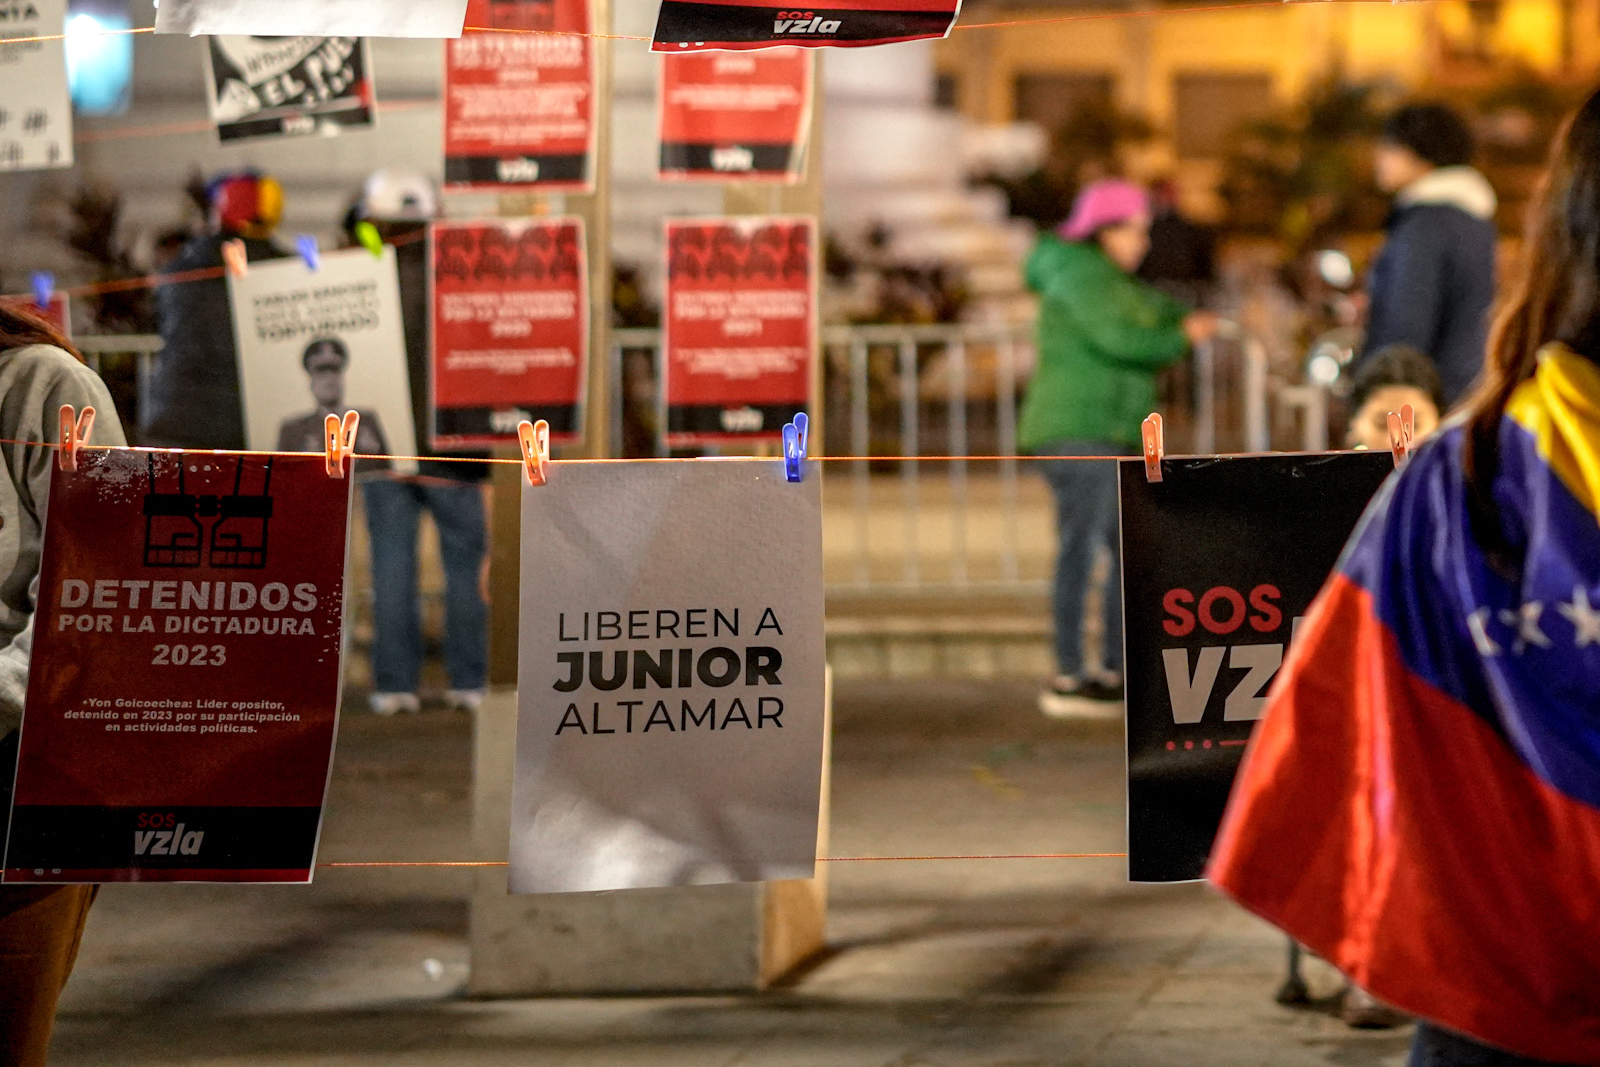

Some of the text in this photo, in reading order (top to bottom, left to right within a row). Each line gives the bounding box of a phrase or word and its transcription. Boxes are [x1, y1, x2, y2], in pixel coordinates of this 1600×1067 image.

[773, 15, 842, 34] vzla
[60, 579, 318, 612] DETENIDOS
[1162, 583, 1282, 636] SOS
[58, 614, 316, 635] POR LA DICTADURA
[559, 607, 784, 642] LIBEREN A
[151, 644, 227, 666] 2023
[552, 645, 783, 692] JUNIOR
[115, 698, 193, 709] Goicoechea:
[231, 700, 286, 712] opositor,
[555, 696, 784, 736] ALTAMAR
[64, 710, 119, 720] detenido
[142, 711, 172, 720] 2023
[176, 713, 196, 723] por
[200, 713, 215, 721] su
[218, 711, 300, 725] participación
[105, 724, 120, 732] en
[124, 723, 197, 732] actividades
[138, 812, 176, 828] SOS
[134, 823, 205, 855] vzla
